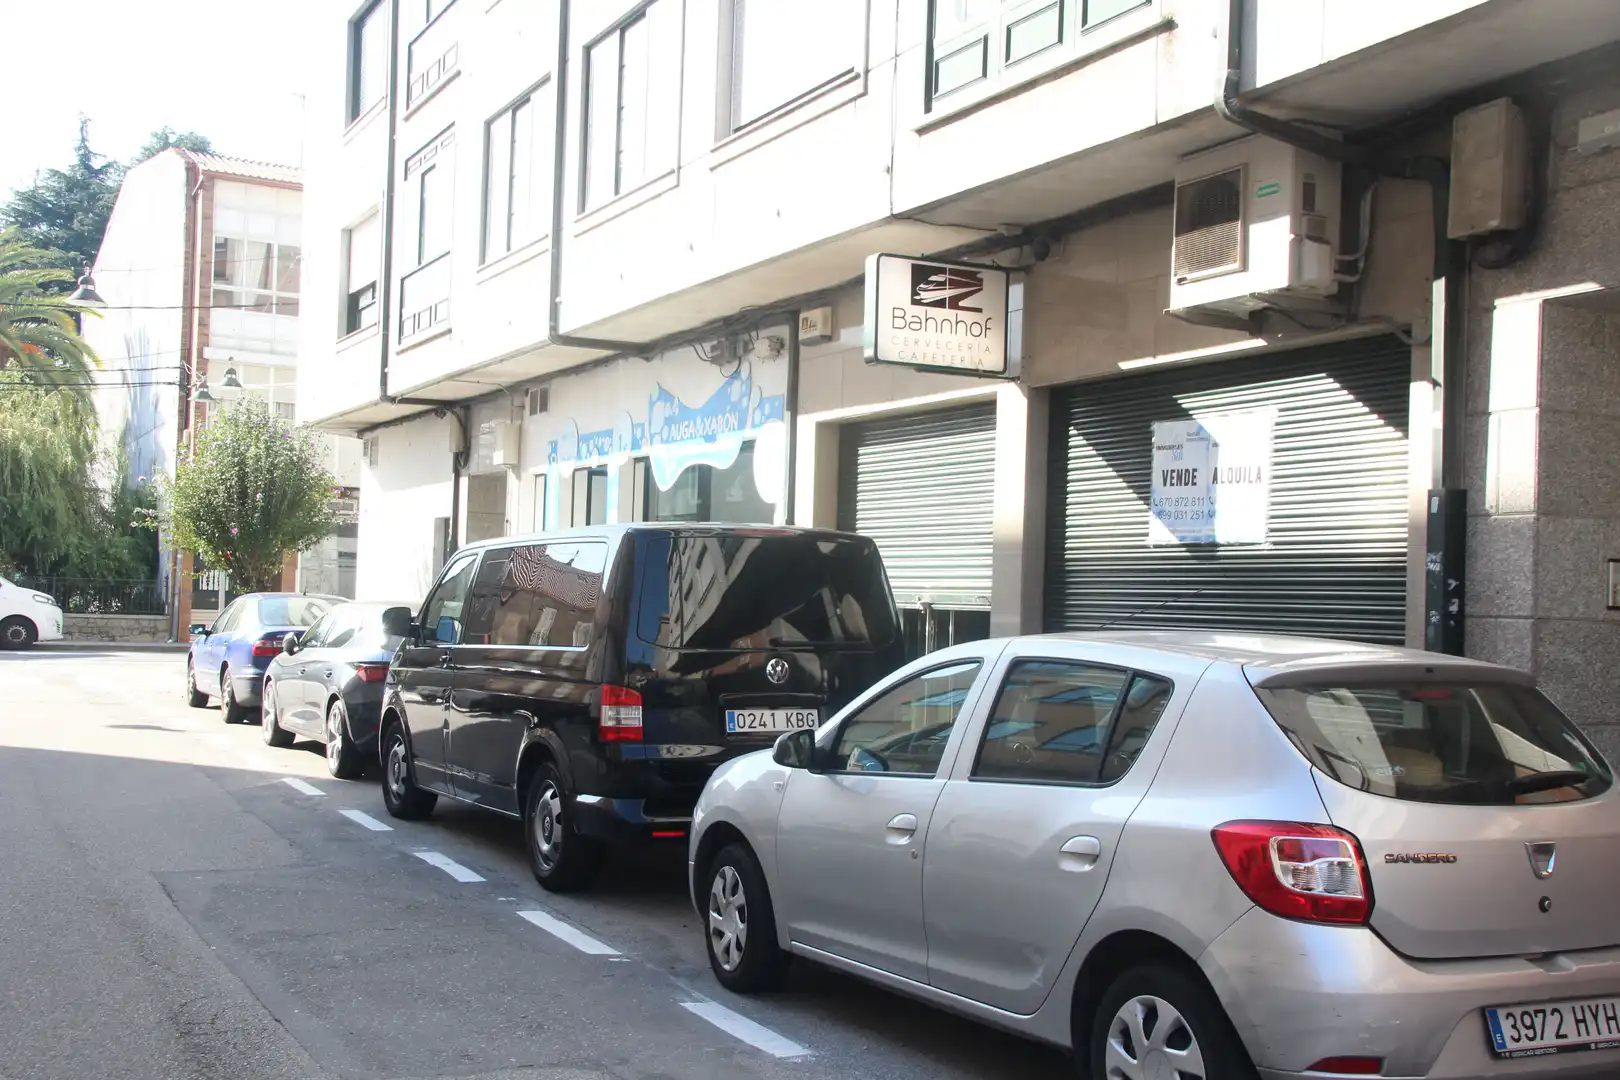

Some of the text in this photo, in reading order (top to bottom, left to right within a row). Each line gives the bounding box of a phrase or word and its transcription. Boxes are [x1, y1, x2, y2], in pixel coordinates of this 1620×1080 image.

[892, 307, 992, 338] Bahnhof
[891, 335, 992, 354] CERVECERÍA
[898, 350, 984, 367] CAFETERÍA
[1162, 468, 1198, 487] VENDE
[1212, 466, 1262, 485] ALQUILA
[1159, 497, 1173, 507] 670
[1174, 497, 1189, 507] 872
[1174, 510, 1188, 520] 031
[1190, 510, 1205, 520] 251
[736, 712, 815, 729] 0241 KBG
[1384, 853, 1458, 864] SANDERO
[1505, 1002, 1620, 1044] 3972 HYH
